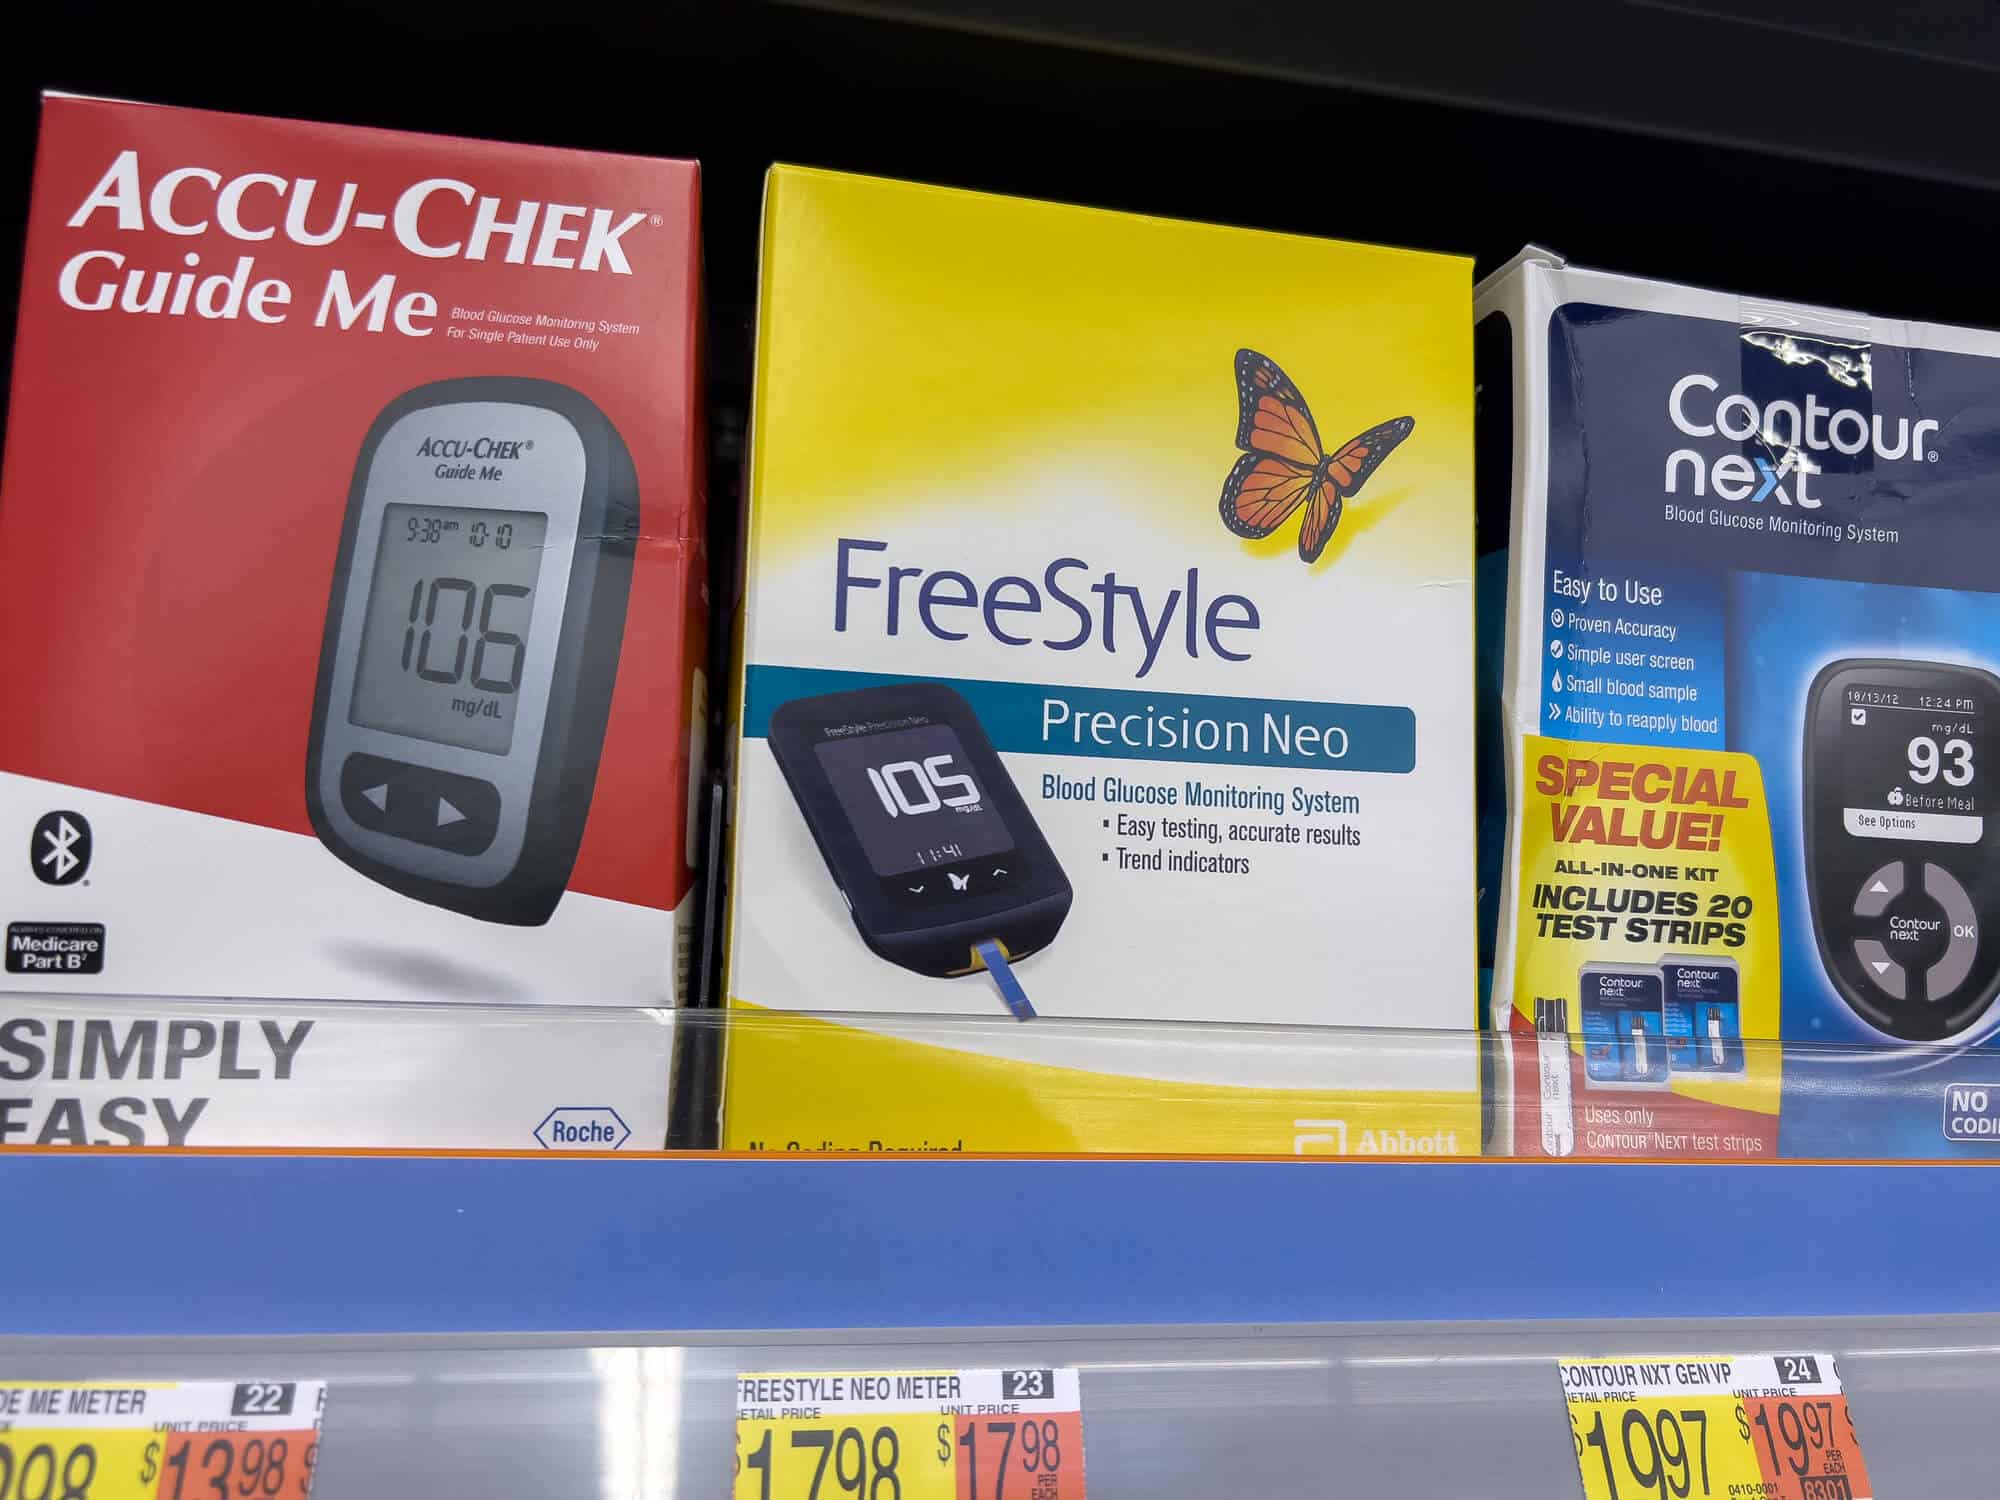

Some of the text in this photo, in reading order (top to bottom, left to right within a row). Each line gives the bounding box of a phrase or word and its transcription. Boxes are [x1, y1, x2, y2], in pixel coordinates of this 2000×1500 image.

[58, 250, 438, 337] Guide Me
[451, 307, 640, 336] Blood Glucose Monitoring System
[447, 326, 600, 353] For Single Patient Use Only
[434, 463, 503, 482] Guide Me
[1664, 448, 1824, 509] next
[1665, 504, 1900, 545] Blood Glucose Monitoring System
[1553, 570, 1663, 606] Easy to Use
[834, 537, 1261, 680] FreeStyle
[401, 577, 532, 695] 106
[1568, 613, 1677, 642] Proven Accuracy
[1567, 643, 1695, 672] Simple user screen
[1566, 674, 1697, 704] Small blood sample
[1848, 691, 1900, 705] 10/13/12
[451, 700, 503, 719] mg/dL
[1919, 696, 1951, 708] 12:24
[1041, 700, 1349, 758] Precision Neo
[1565, 706, 1719, 735] Ability to reapply blood
[1931, 723, 1974, 736] mg/dL
[1907, 736, 1975, 787] 93
[866, 754, 981, 818] 105
[1535, 754, 1749, 810] SPECIAL
[1042, 773, 1360, 816] Blood Glucose Monitoring System
[1906, 793, 1975, 811] Before Meal
[1117, 813, 1361, 847] Easy testing, accurate results
[1551, 802, 1725, 852] VALUE!
[1858, 814, 1916, 830] See Options
[916, 842, 963, 866] 11:41
[1116, 846, 1250, 874] Trend indicators
[1554, 859, 1719, 882] ALL-IN-ONE KIT
[1532, 883, 1753, 919] INCLUDES 20
[1536, 913, 1746, 947] TEST STRIPS
[1889, 915, 1941, 931] Contour
[1889, 928, 1920, 941] next
[1953, 924, 1975, 939] OK
[12, 936, 99, 952] Medicare
[22, 953, 63, 969] Part
[1600, 976, 1642, 989] Contour
[1677, 967, 1718, 981] Contour
[1677, 978, 1701, 988] next
[1600, 986, 1625, 997] next
[0, 1018, 316, 1082] SIMPLY
[1952, 1090, 1988, 1112] NO
[1584, 1105, 1654, 1128] Uses only
[1951, 1117, 2000, 1134] CODI
[552, 1120, 615, 1142] Roche
[1358, 1129, 1458, 1154] Abbott
[1692, 1134, 1719, 1151] test
[1722, 1134, 1762, 1155] strips
[1641, 1363, 1672, 1385] NXT
[1675, 1363, 1711, 1385] GEN
[1711, 1362, 1732, 1384] VP
[1783, 1358, 1811, 1381] 24
[850, 1377, 890, 1400] NEO
[896, 1375, 960, 1399] METER
[1012, 1371, 1044, 1396] 23
[1733, 1387, 1797, 1398] UNIT PRICE
[28, 1389, 61, 1414] ME
[67, 1388, 146, 1414] METER
[243, 1384, 282, 1412] 22
[1603, 1391, 1637, 1402] PRICE
[737, 1407, 822, 1420] ETAIL PRICE
[940, 1403, 1020, 1416] UNIT PRICE
[153, 1420, 248, 1432] UNIT PRICE
[1825, 1450, 1842, 1459] PER
[1823, 1463, 1846, 1474] EACH
[1728, 1482, 1779, 1495] 0410-0001
